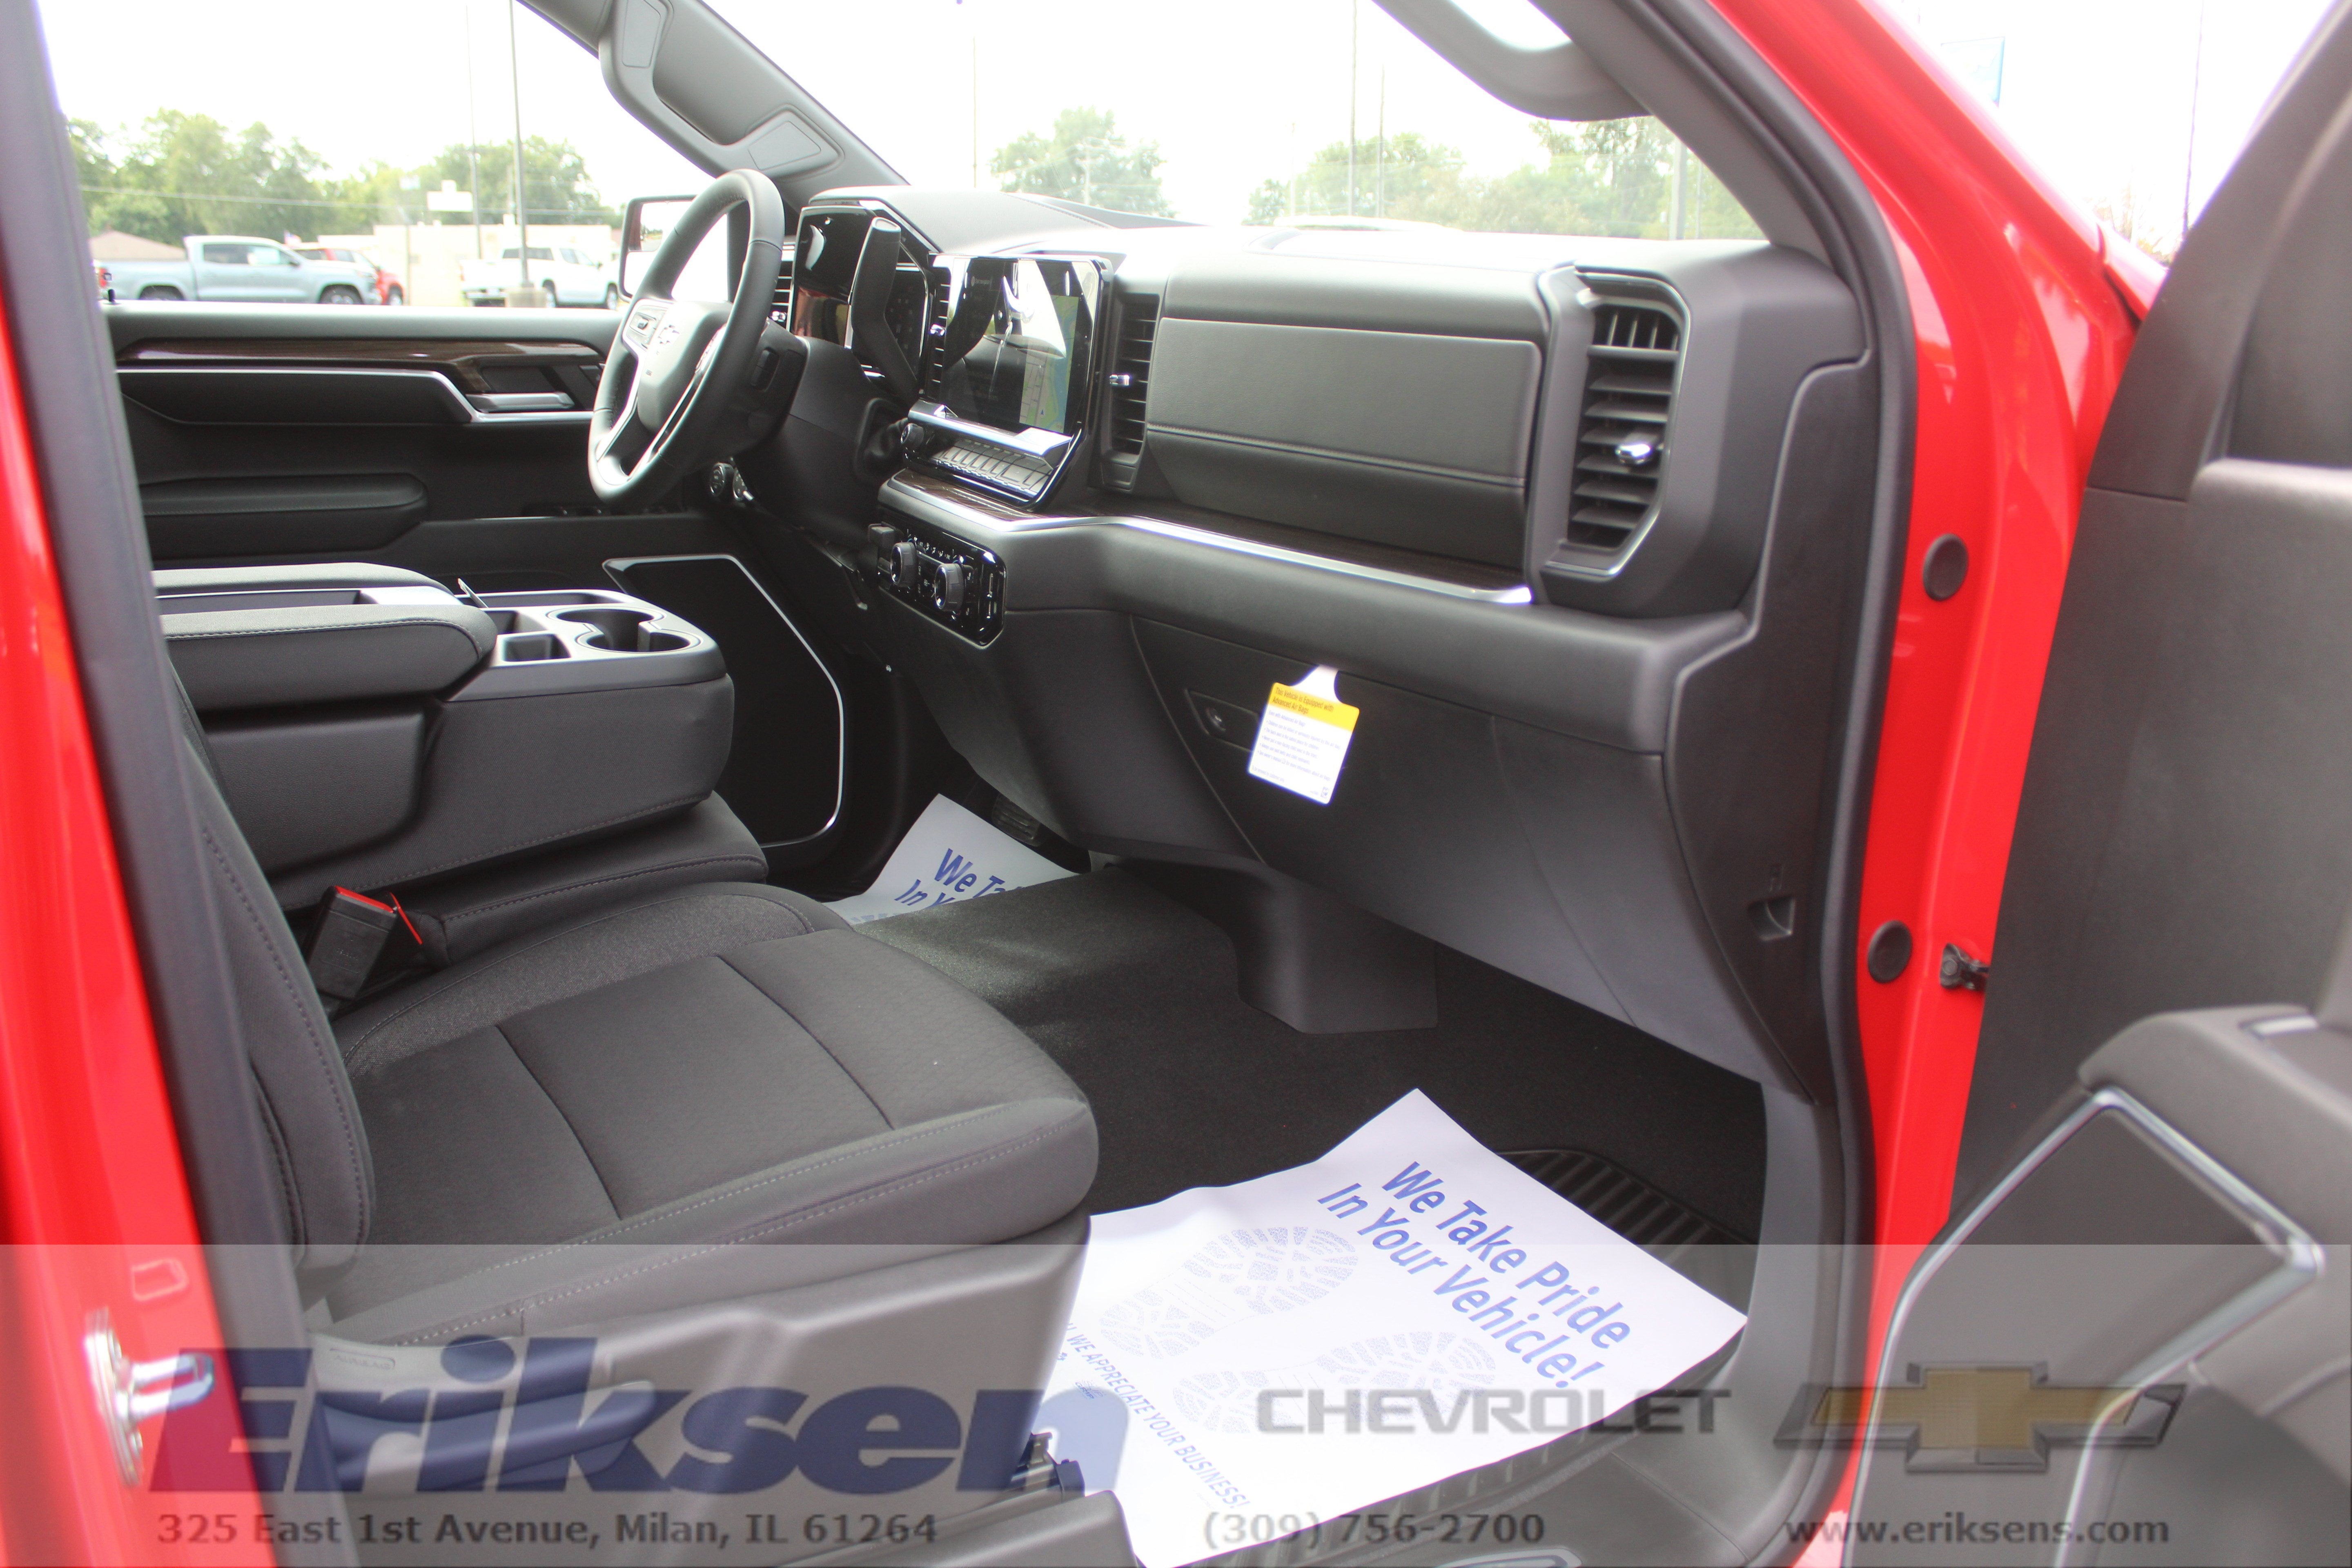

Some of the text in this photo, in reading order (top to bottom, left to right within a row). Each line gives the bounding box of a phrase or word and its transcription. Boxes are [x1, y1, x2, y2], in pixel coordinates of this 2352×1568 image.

[1272, 695, 1292, 708] Advanced
[1297, 704, 1310, 715] Bags
[1274, 687, 1284, 696] This
[1283, 690, 1299, 701] Vehicle
[1302, 696, 1324, 710] Equipped
[1323, 703, 1334, 712] with
[934, 848, 977, 892] We
[894, 879, 927, 906] In
[1382, 1161, 1630, 1349] We Take Pride
[1318, 1183, 1605, 1388] In Your Vehicle!
[1067, 1334, 1096, 1352] WE
[1082, 1354, 1156, 1414] APPRECIATE
[1143, 1412, 1186, 1446] YOUR
[1174, 1445, 1251, 1508] BUSINESS!
